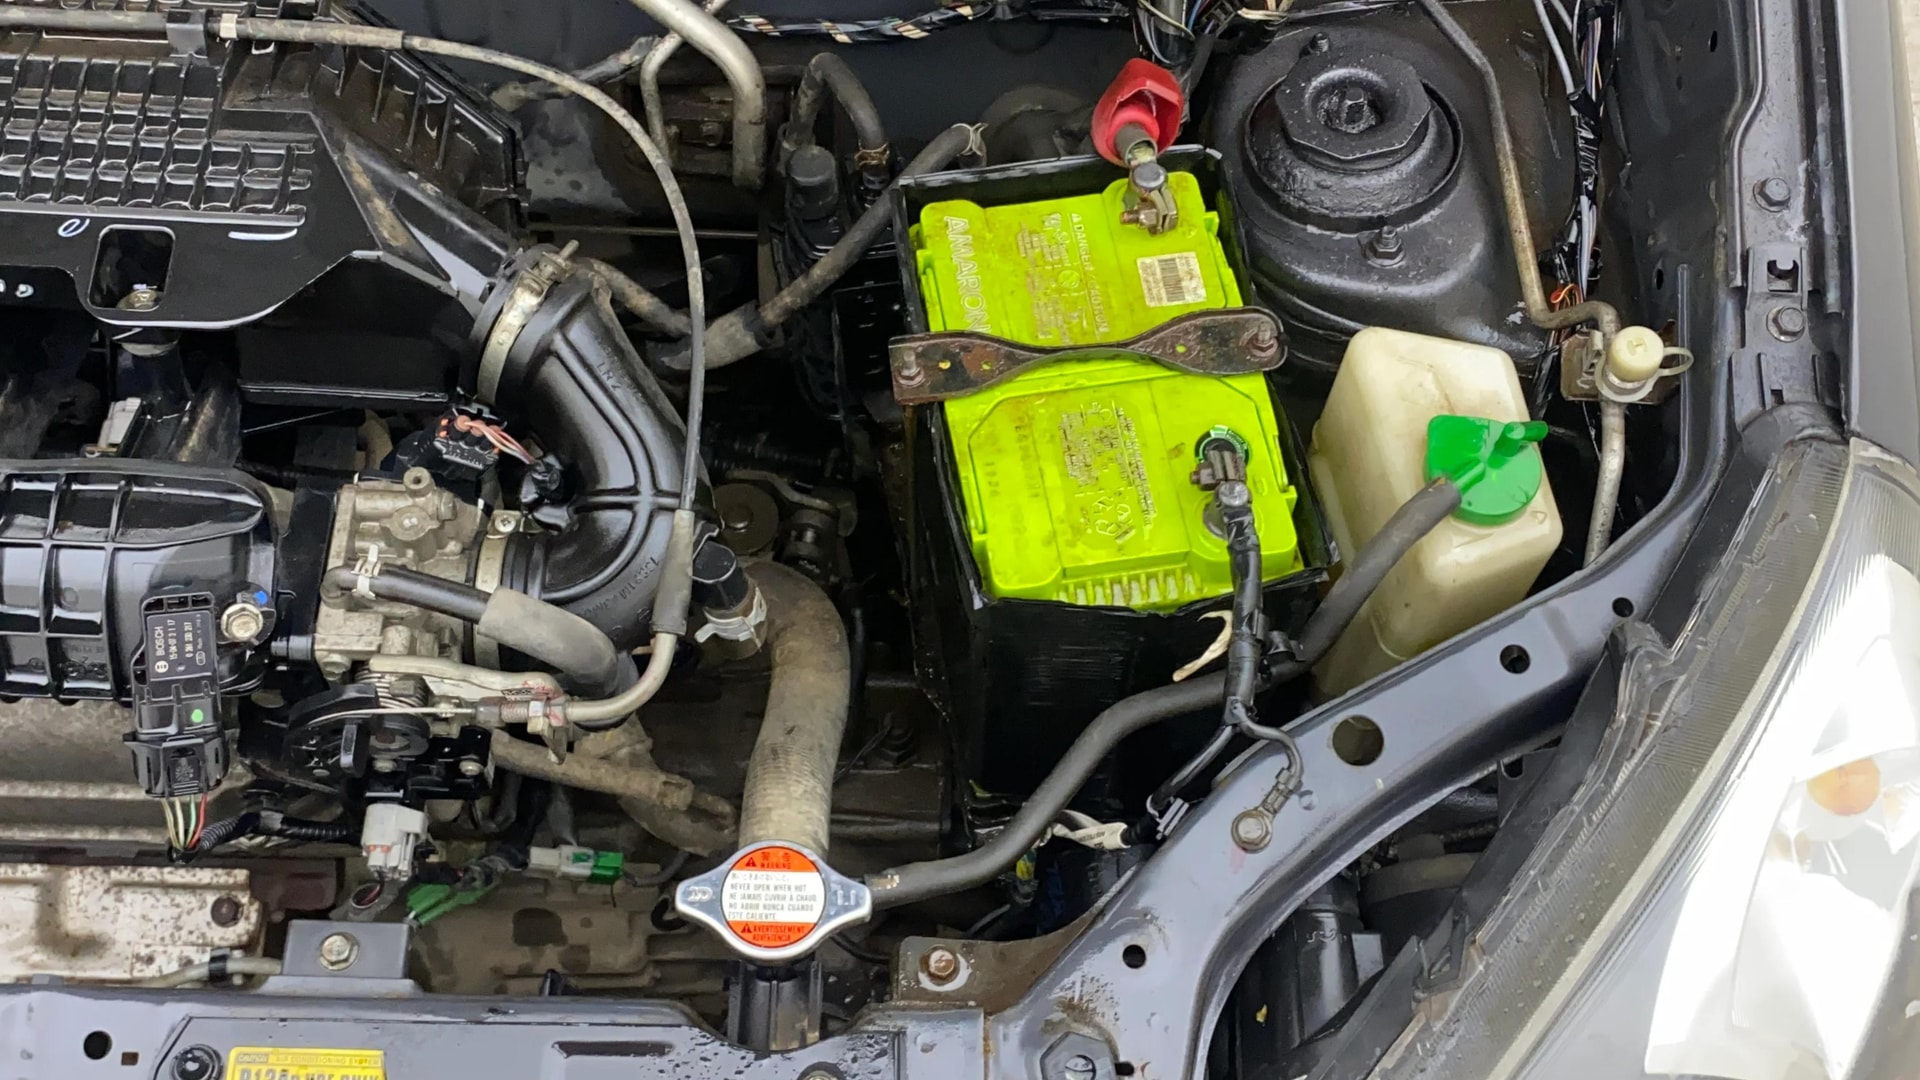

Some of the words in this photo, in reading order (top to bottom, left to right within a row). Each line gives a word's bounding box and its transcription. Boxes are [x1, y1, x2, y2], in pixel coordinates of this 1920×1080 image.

[943, 215, 992, 333] AMARON
[154, 625, 165, 657] BOSCH
[730, 883, 751, 891] NEVER
[753, 884, 770, 892] OPEN
[773, 884, 792, 892] WHEN
[729, 892, 737, 900] NE
[740, 892, 763, 901] JAMAIS
[729, 902, 738, 910] NO
[740, 902, 760, 911] ABRIR
[763, 903, 785, 911] NUNCA
[787, 904, 814, 912] CUANDO
[745, 912, 776, 920] CALIENTE
